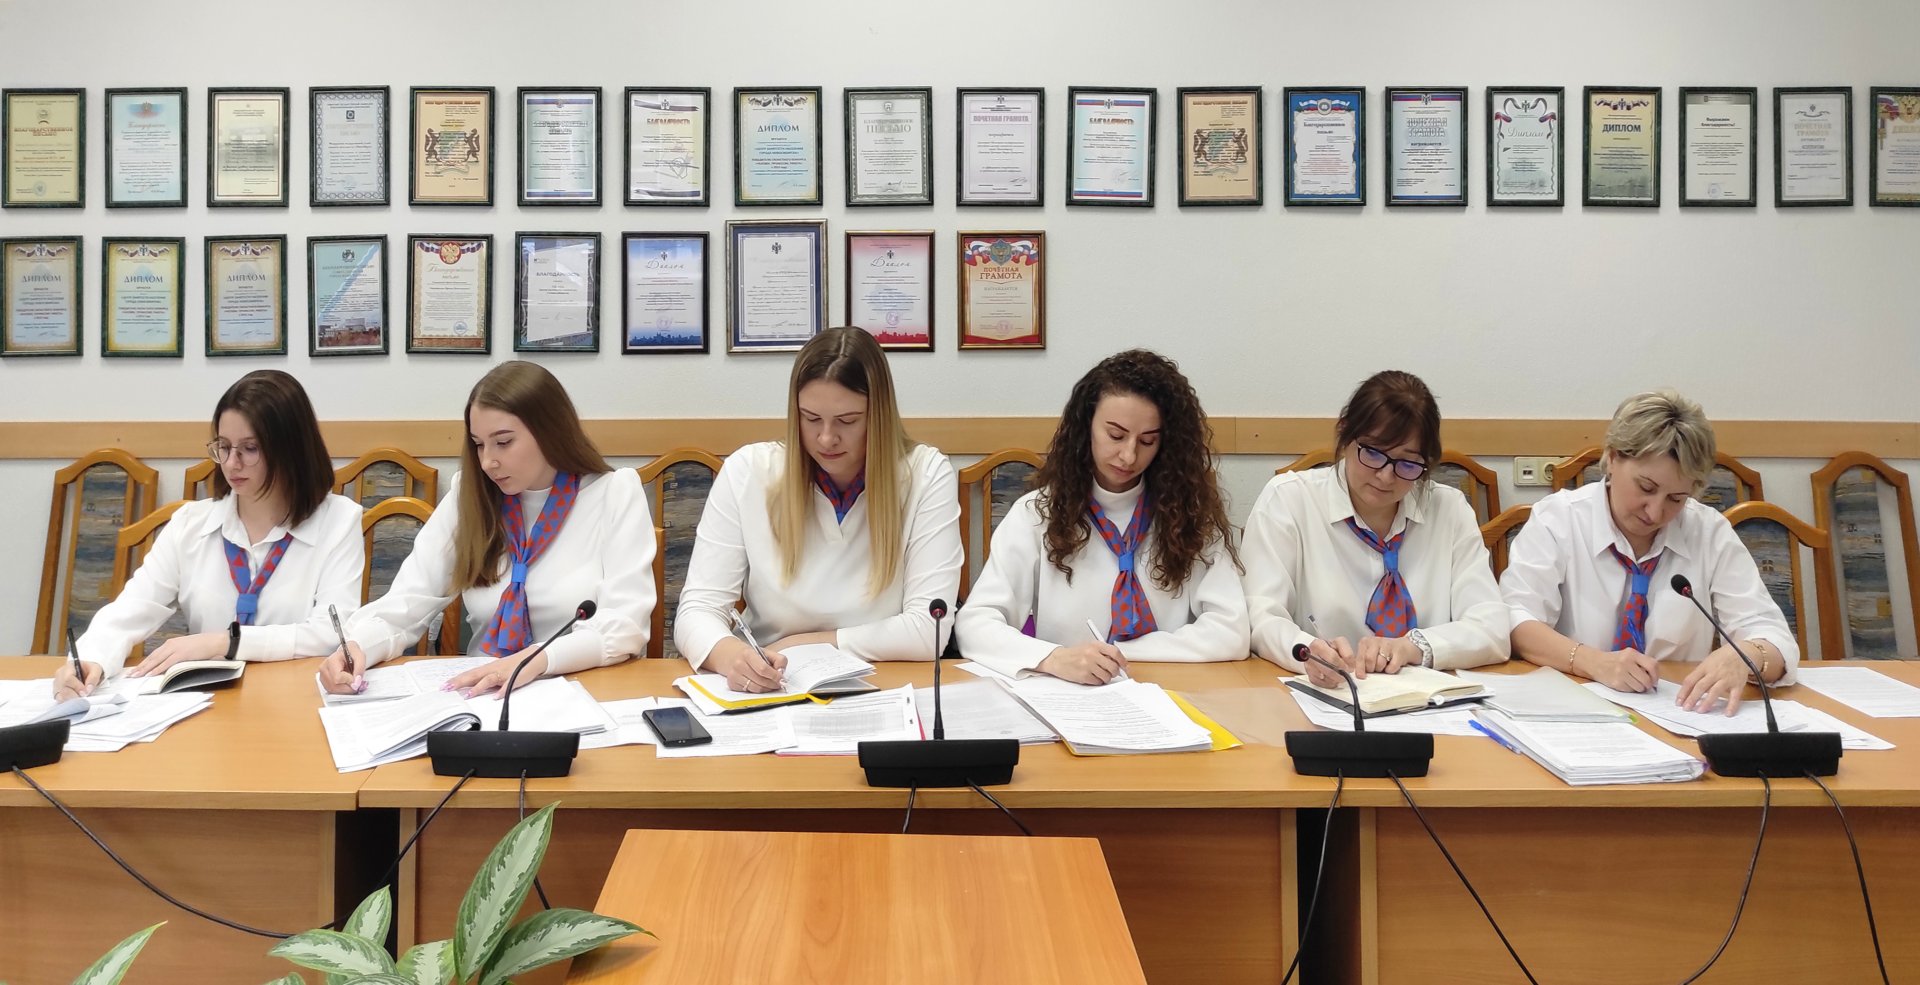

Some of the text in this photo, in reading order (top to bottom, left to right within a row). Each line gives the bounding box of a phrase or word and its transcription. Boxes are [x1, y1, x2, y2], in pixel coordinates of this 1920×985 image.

[757, 124, 800, 132] ДИПЛОМ
[1602, 123, 1642, 133] ДИПЛОМ
[124, 275, 163, 283] ДИПЛОМ
[226, 274, 266, 282] ДИПЛОМ
